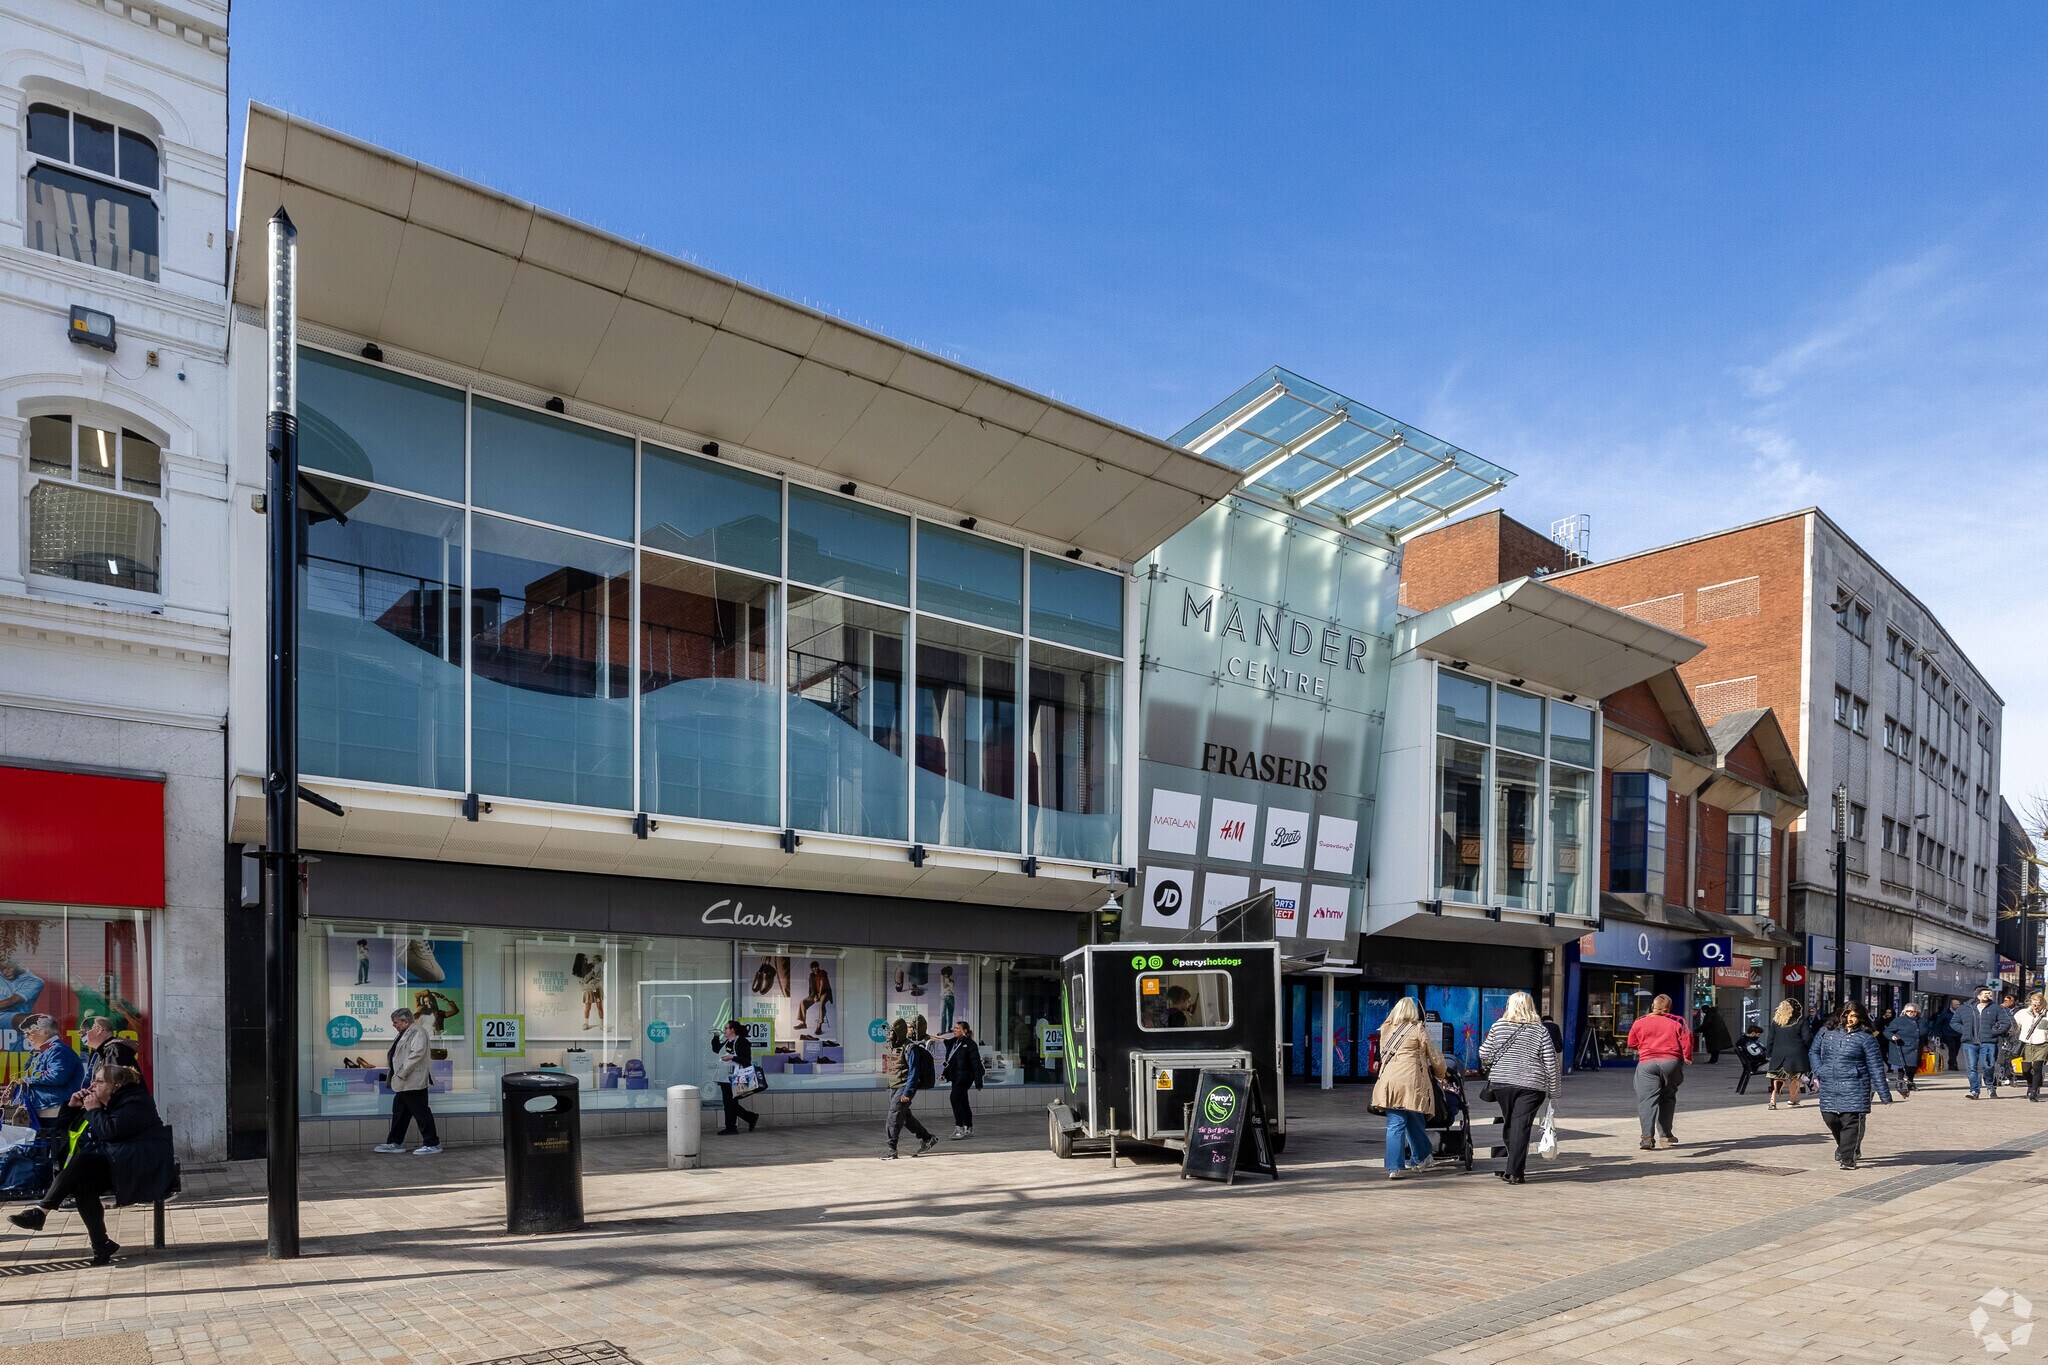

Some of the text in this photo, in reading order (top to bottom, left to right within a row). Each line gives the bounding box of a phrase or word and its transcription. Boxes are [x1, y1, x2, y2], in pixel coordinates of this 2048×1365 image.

[1182, 586, 1367, 674] MANDER
[1227, 656, 1325, 698] CENTRE
[1200, 741, 1328, 792] FRASERS
[1153, 815, 1197, 829] MATALAN
[1220, 819, 1245, 842] H&M
[1271, 826, 1301, 848] Boots
[1156, 888, 1180, 908] JD
[1207, 899, 1223, 907] NEW
[1275, 899, 1294, 909] ORTS
[701, 899, 793, 928] Clarks
[1326, 907, 1344, 919] hmv
[1638, 932, 1651, 961] O2
[1702, 943, 1725, 962] O2
[1172, 956, 1242, 968] @percyshotdogs
[1872, 953, 1891, 968] TESCO
[350, 993, 379, 1001] THERE'S
[331, 1027, 358, 1039] £60
[362, 1024, 385, 1034] arks
[486, 1021, 516, 1037] 20%
[650, 1028, 667, 1038] £28
[1209, 1093, 1233, 1103] Percy's
